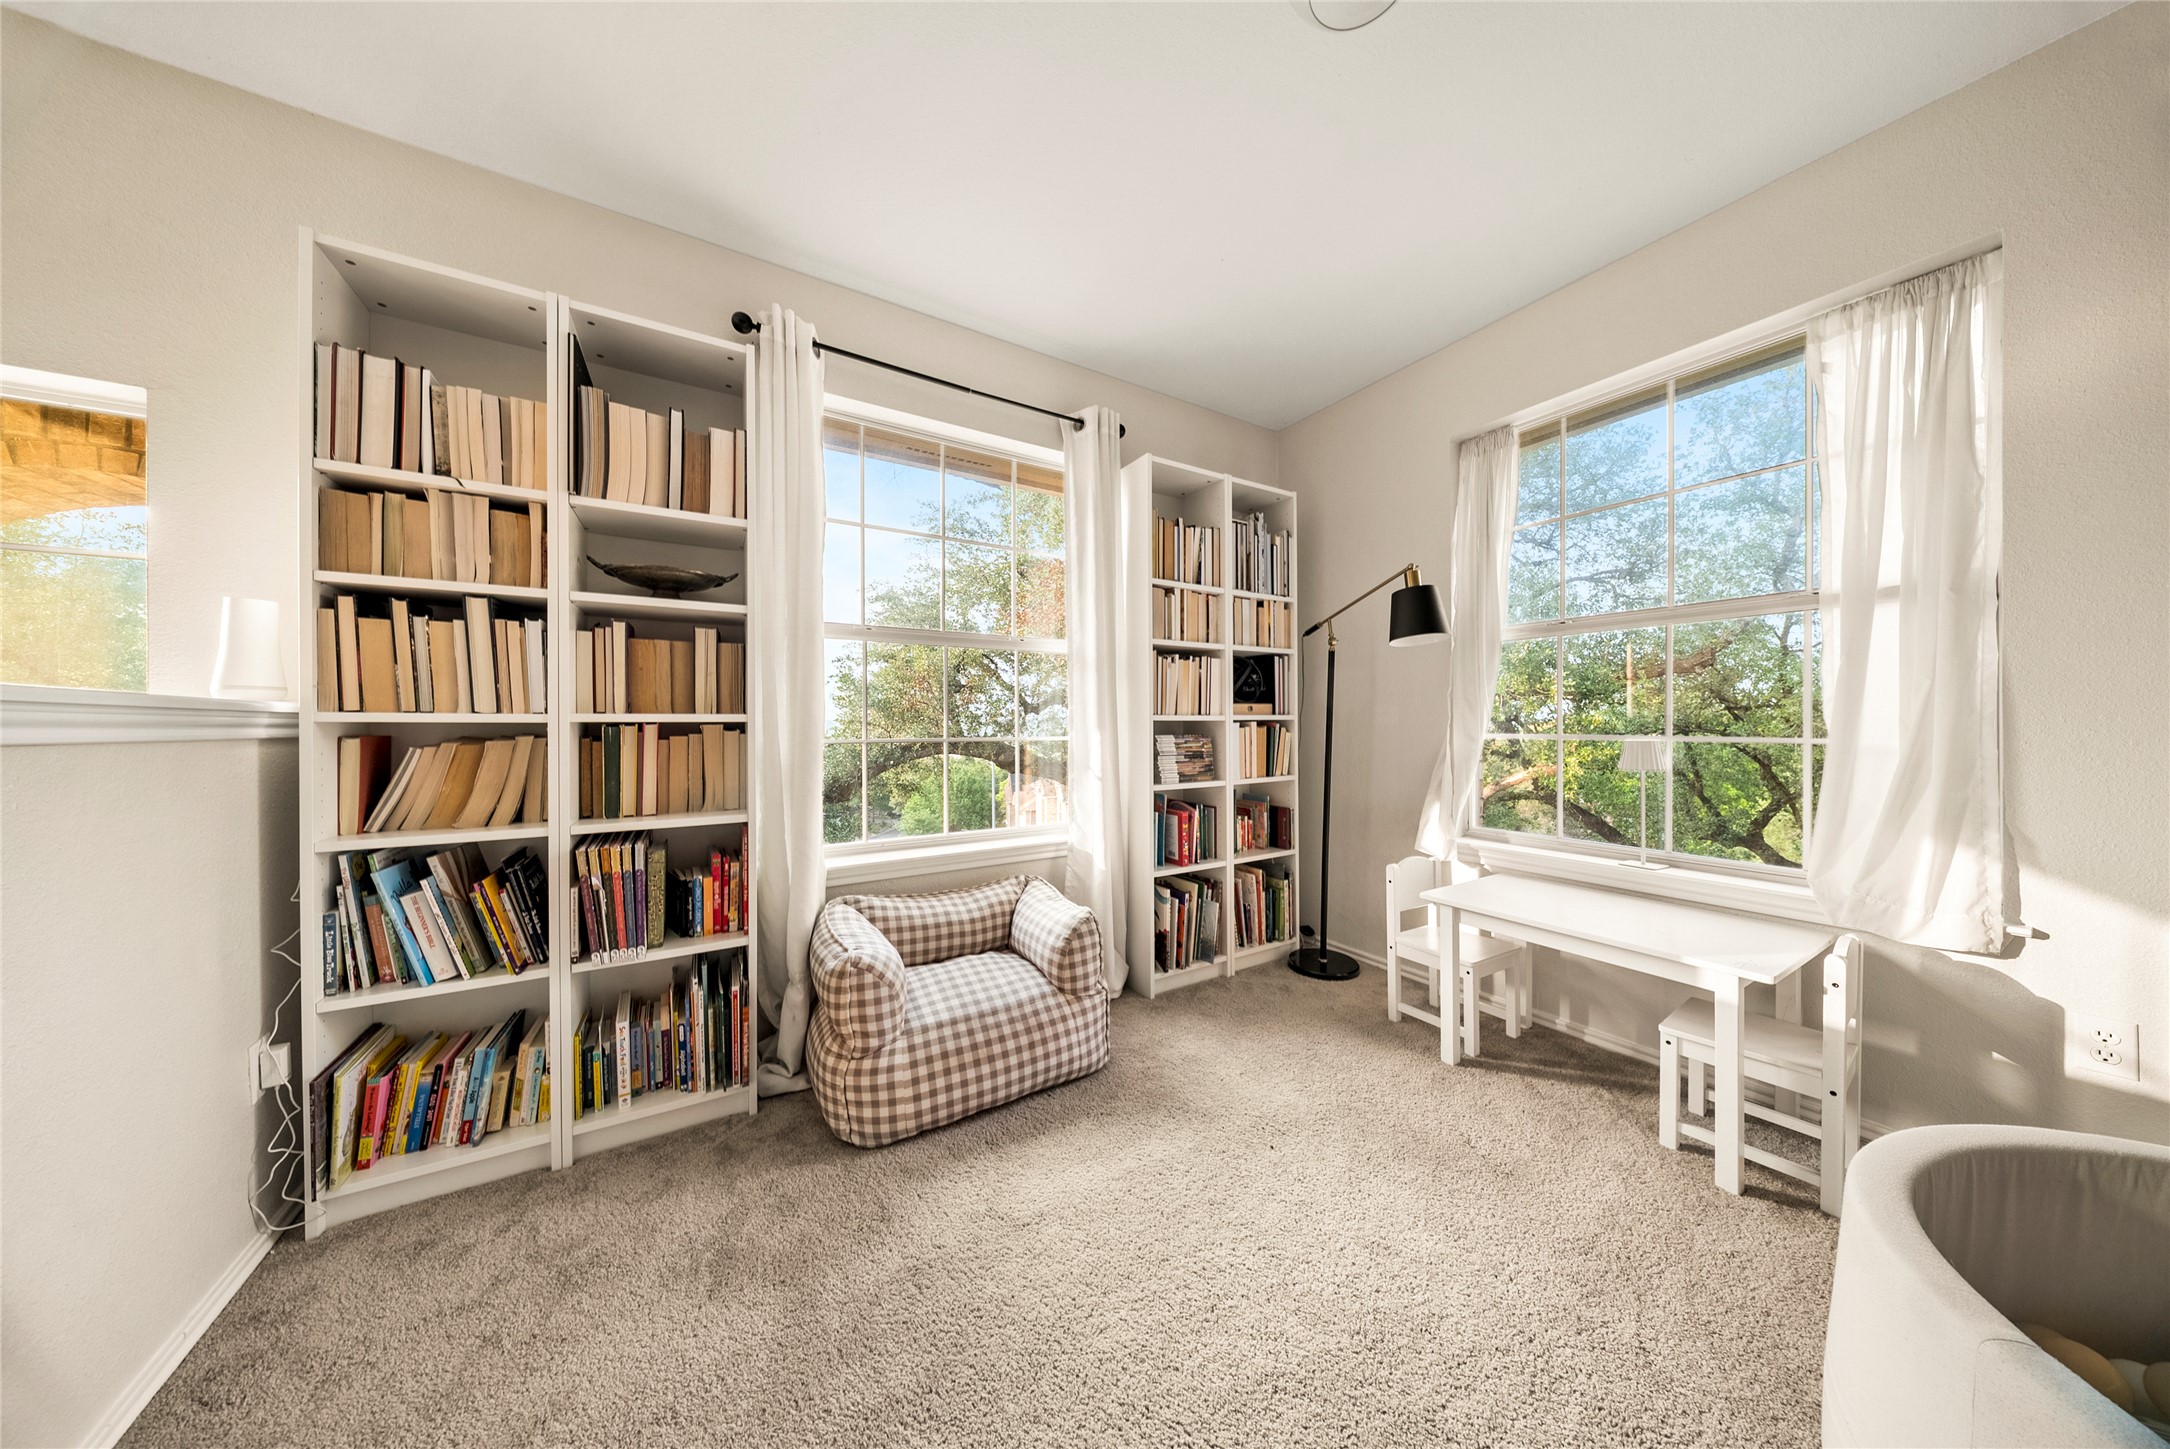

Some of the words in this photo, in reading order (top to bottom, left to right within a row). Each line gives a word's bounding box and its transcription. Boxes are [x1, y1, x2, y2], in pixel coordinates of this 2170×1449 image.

[410, 895, 418, 906] THE
[412, 905, 430, 934] BEGINNER'S
[325, 931, 334, 948] Little
[424, 934, 436, 949] BIBLE
[326, 949, 334, 962] Blue
[326, 962, 334, 983] Truck
[468, 1089, 476, 1104] Apple
